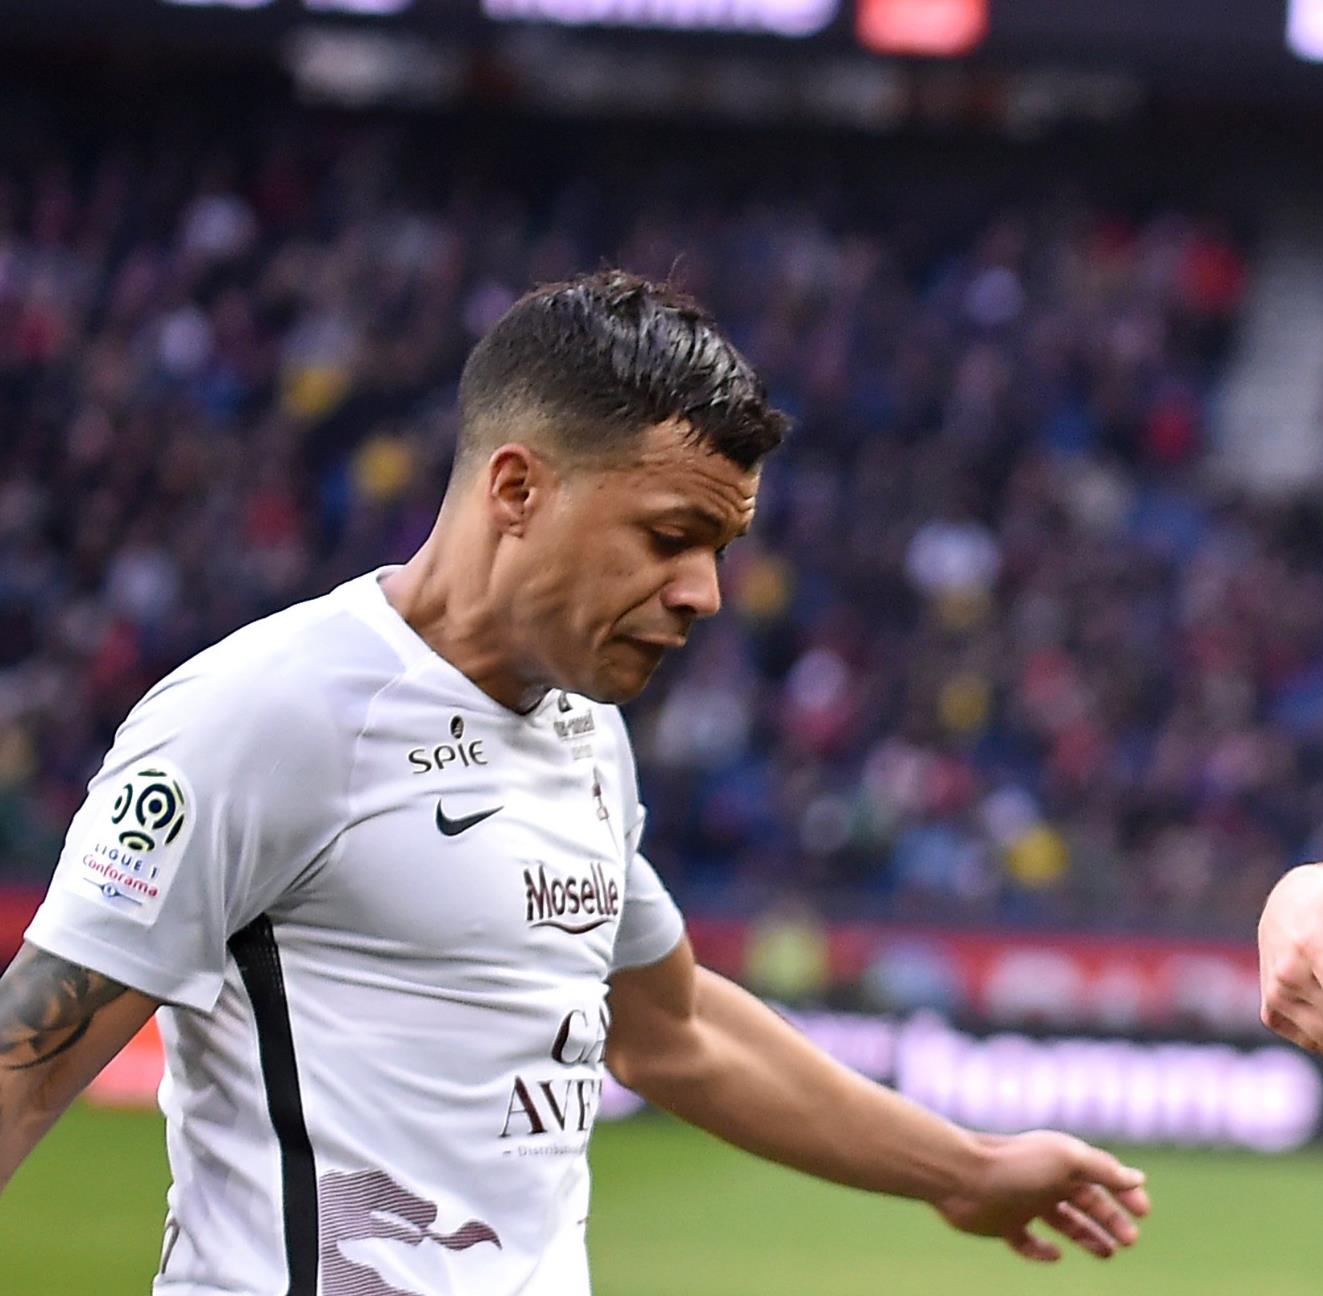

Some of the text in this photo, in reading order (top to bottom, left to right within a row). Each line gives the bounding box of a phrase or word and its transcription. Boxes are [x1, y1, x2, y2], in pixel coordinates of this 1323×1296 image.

[408, 738, 488, 775] SPIE
[83, 854, 158, 897] Conforama
[95, 843, 142, 871] LIGUE
[523, 862, 618, 921] Moselle
[499, 1074, 603, 1138] AVE
